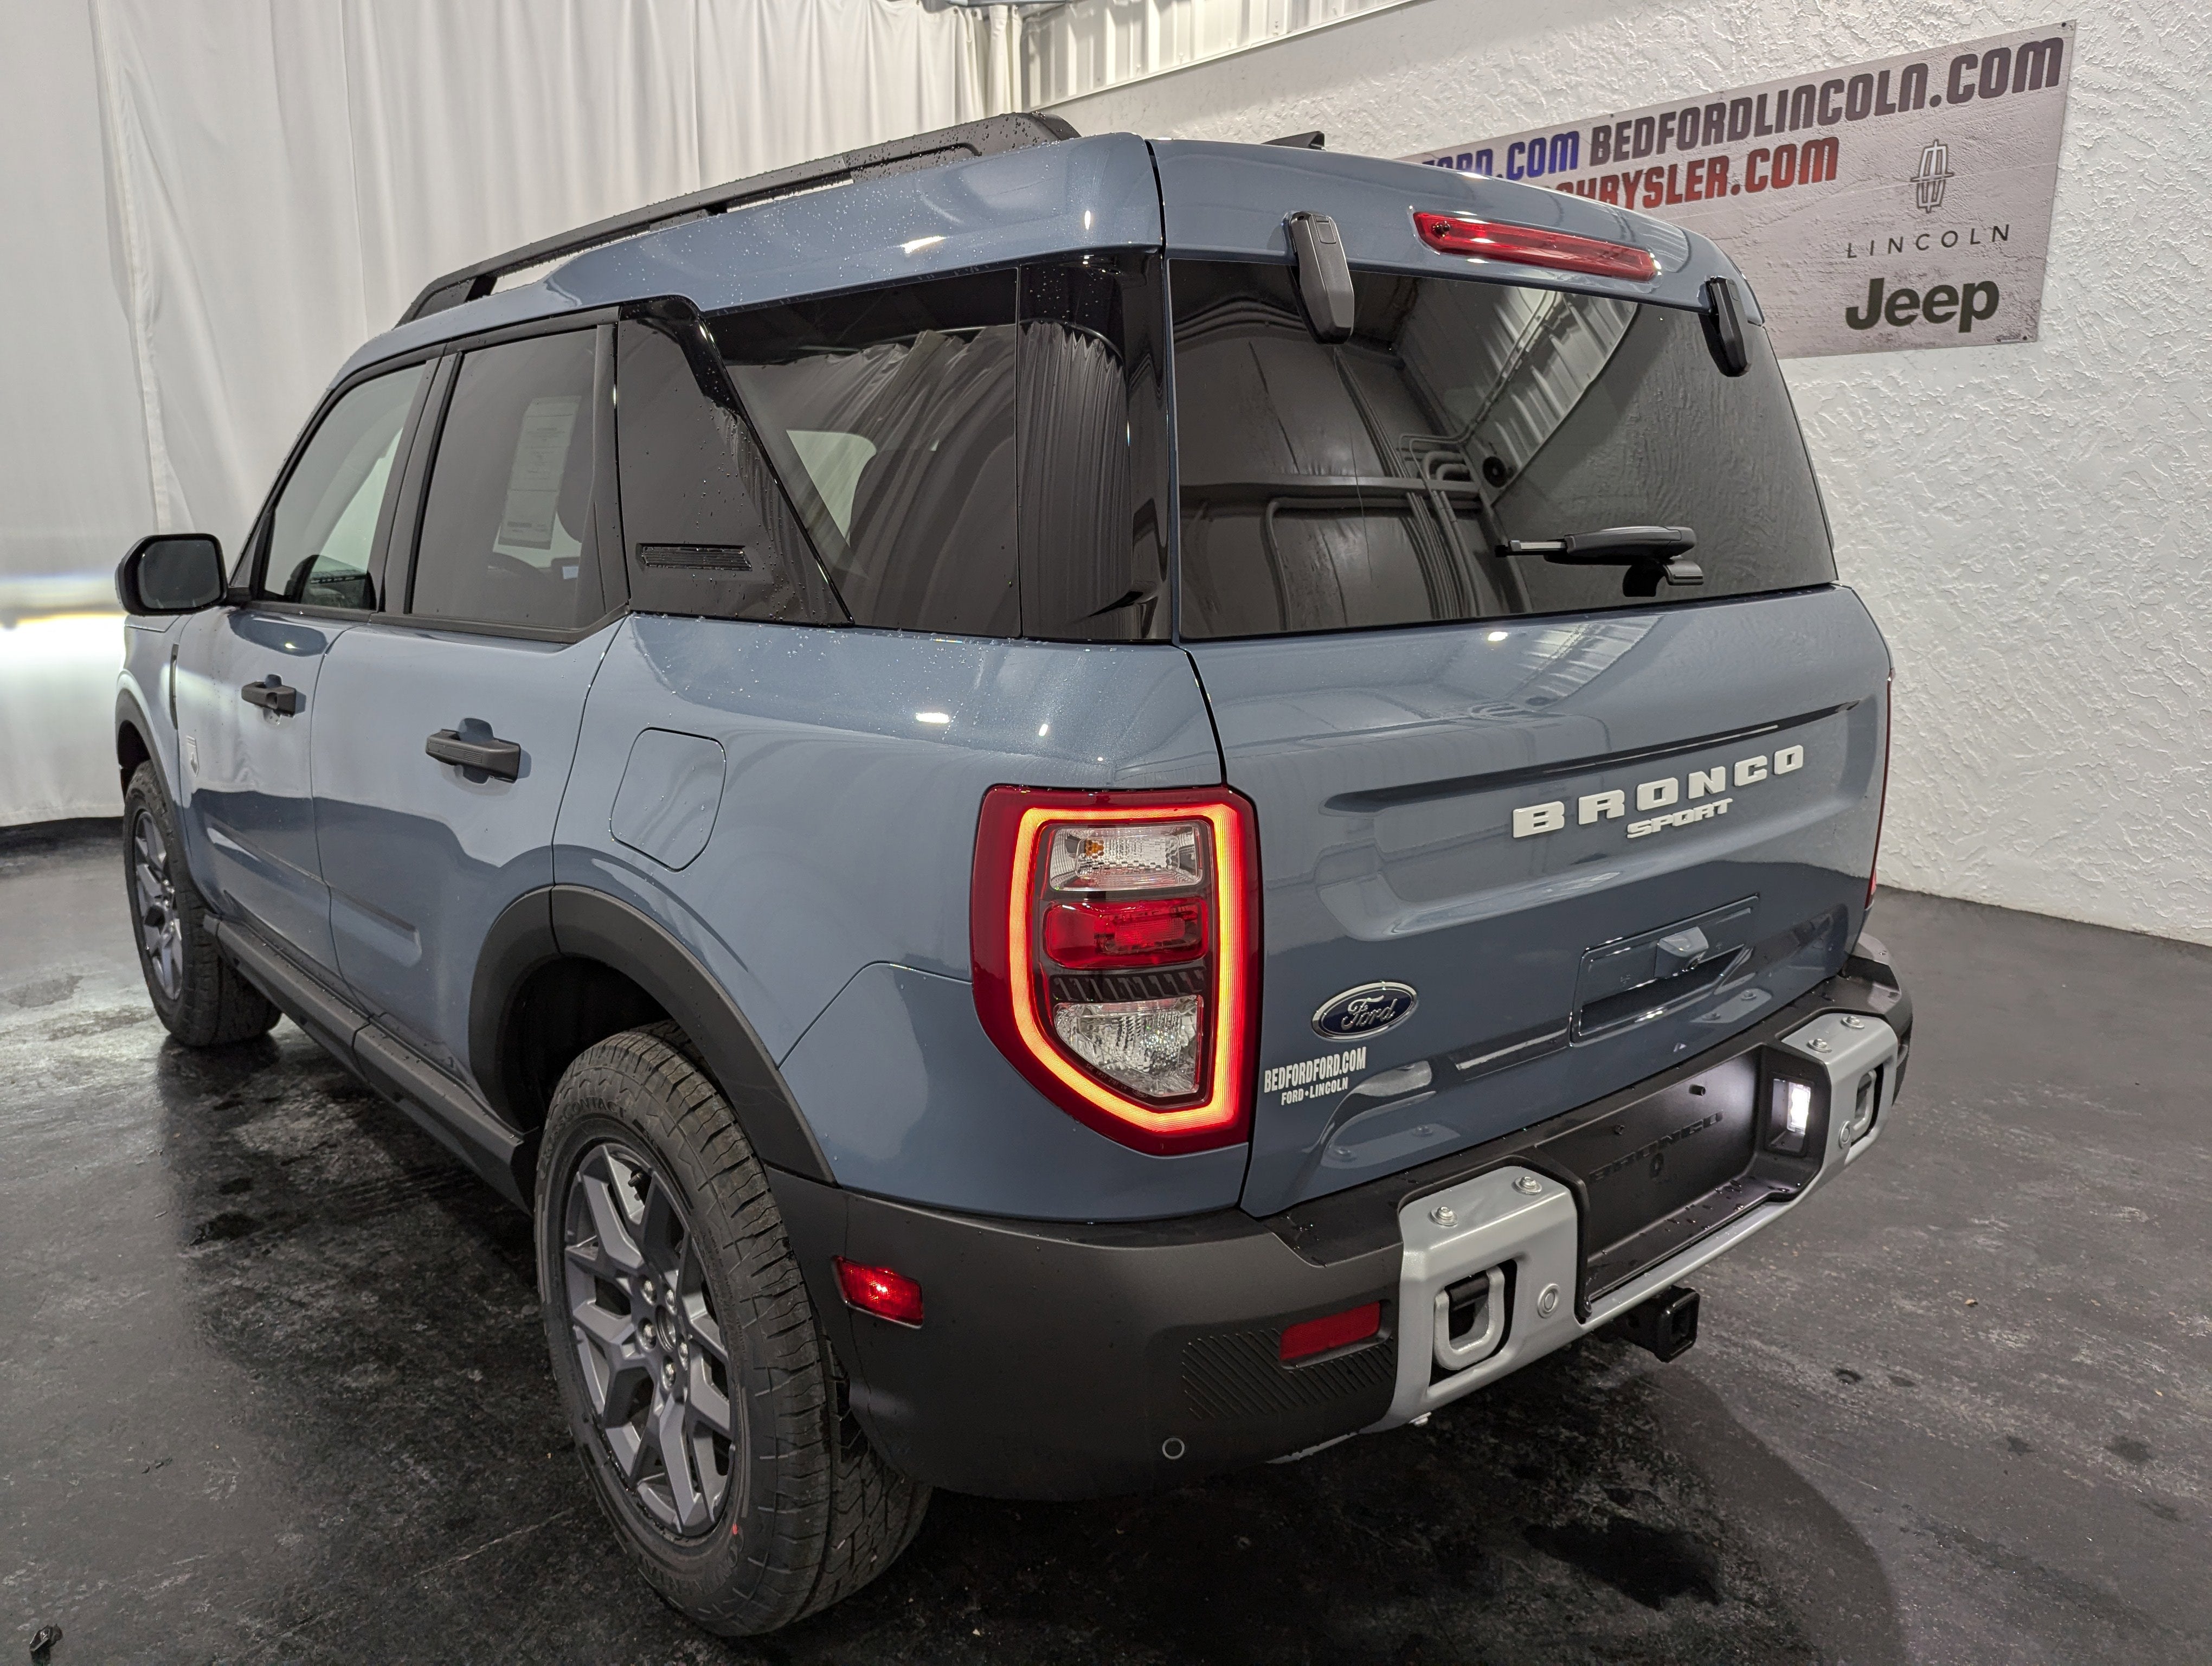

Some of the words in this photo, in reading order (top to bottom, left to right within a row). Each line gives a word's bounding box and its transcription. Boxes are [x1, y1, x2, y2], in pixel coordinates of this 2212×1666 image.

[1422, 131, 1580, 181] D.COM
[1590, 37, 2064, 166] BEDFORDLINCOLN.COM
[1556, 137, 1840, 210] RYSLER.COM
[1847, 224, 2009, 259] LINCOLN
[1845, 278, 1999, 334] Jeep
[1513, 745, 1804, 838] BRONCO
[1627, 798, 1733, 838] SPORT
[1341, 995, 1398, 1030] Ford
[1264, 1046, 1367, 1093] BEDFORDFORD.COM
